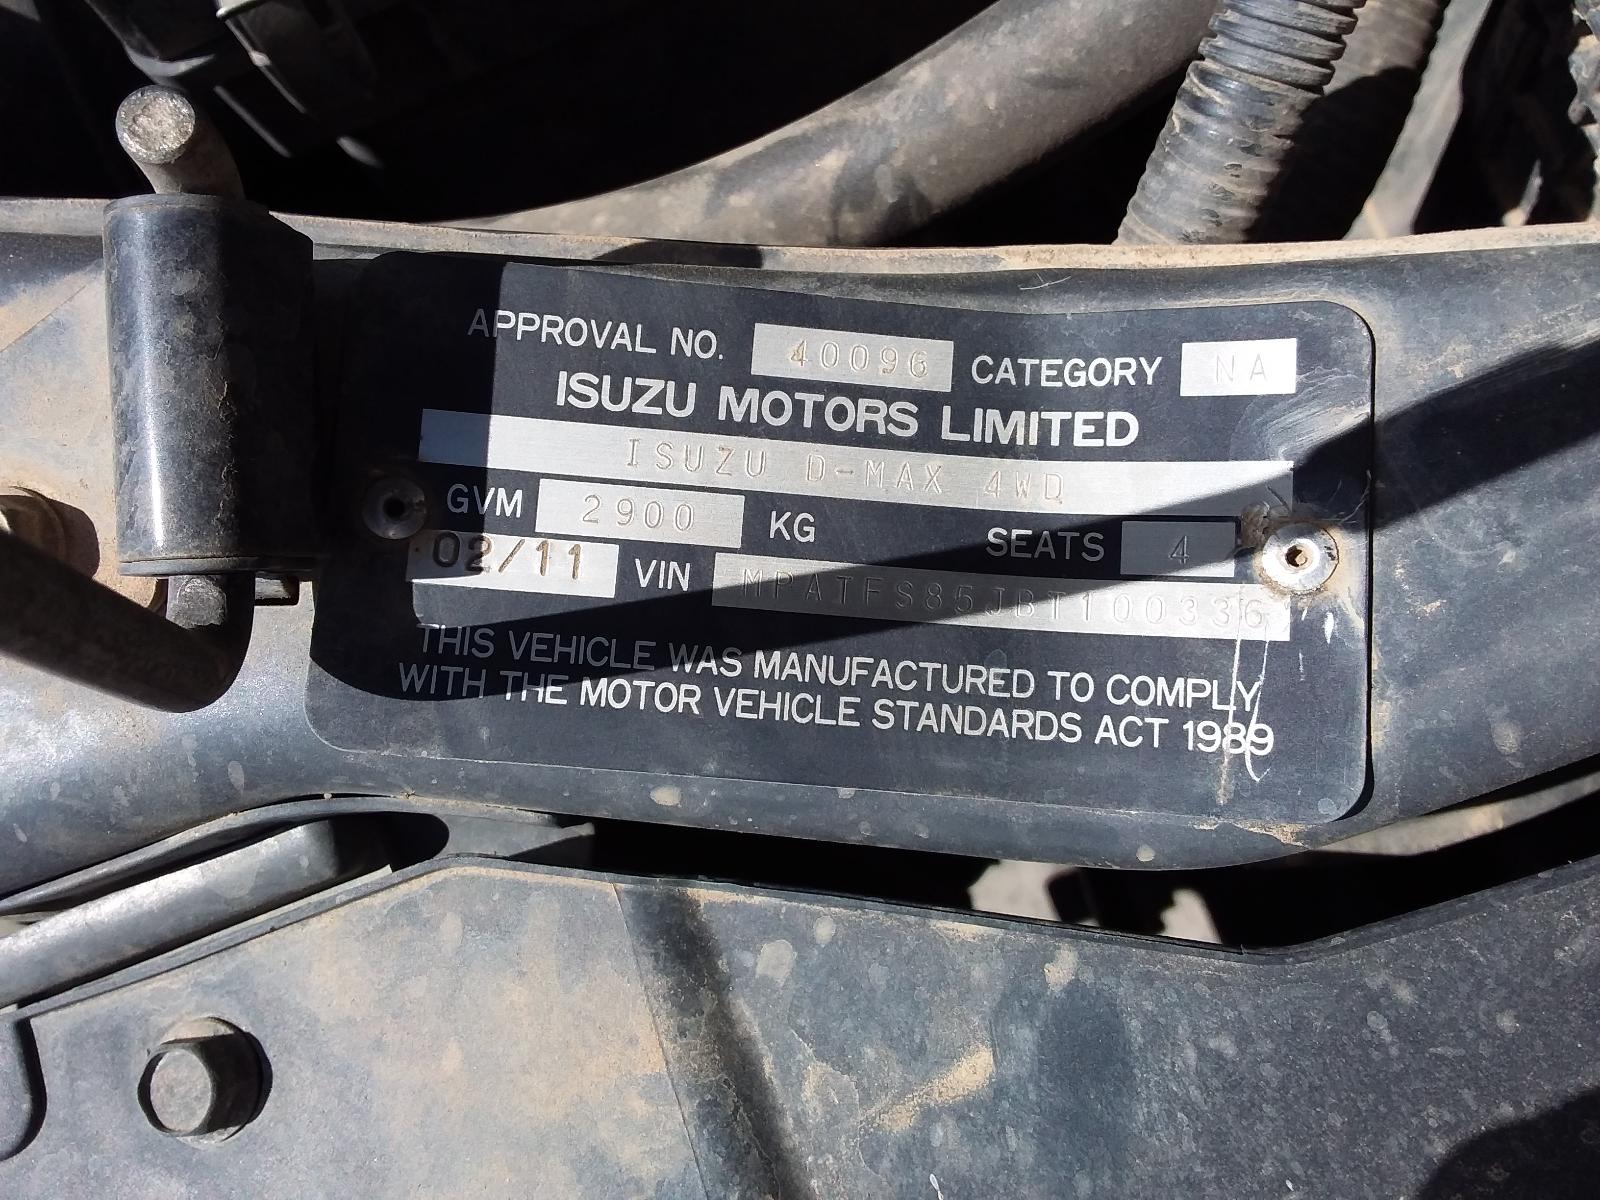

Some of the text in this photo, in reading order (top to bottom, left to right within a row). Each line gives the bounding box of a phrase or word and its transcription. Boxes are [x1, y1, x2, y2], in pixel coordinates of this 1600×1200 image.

[468, 308, 1269, 387] APPROVAL NO. 40096 CATEGORY NA
[556, 370, 1139, 447] ISUZU MOTORS LIMITED
[626, 436, 1065, 505] ISUZU D-MAX 4WD
[432, 531, 583, 581] 02/11
[634, 558, 691, 591] VIN
[446, 483, 1189, 565] GVM 2900 KG SEATS 4
[417, 624, 1260, 711] THIS VEHICLE WAS MANUFACTURED TO COMPLY
[399, 662, 1274, 756] WITH THE MOTOR VEHICLE STANDARDS ACT 1989
